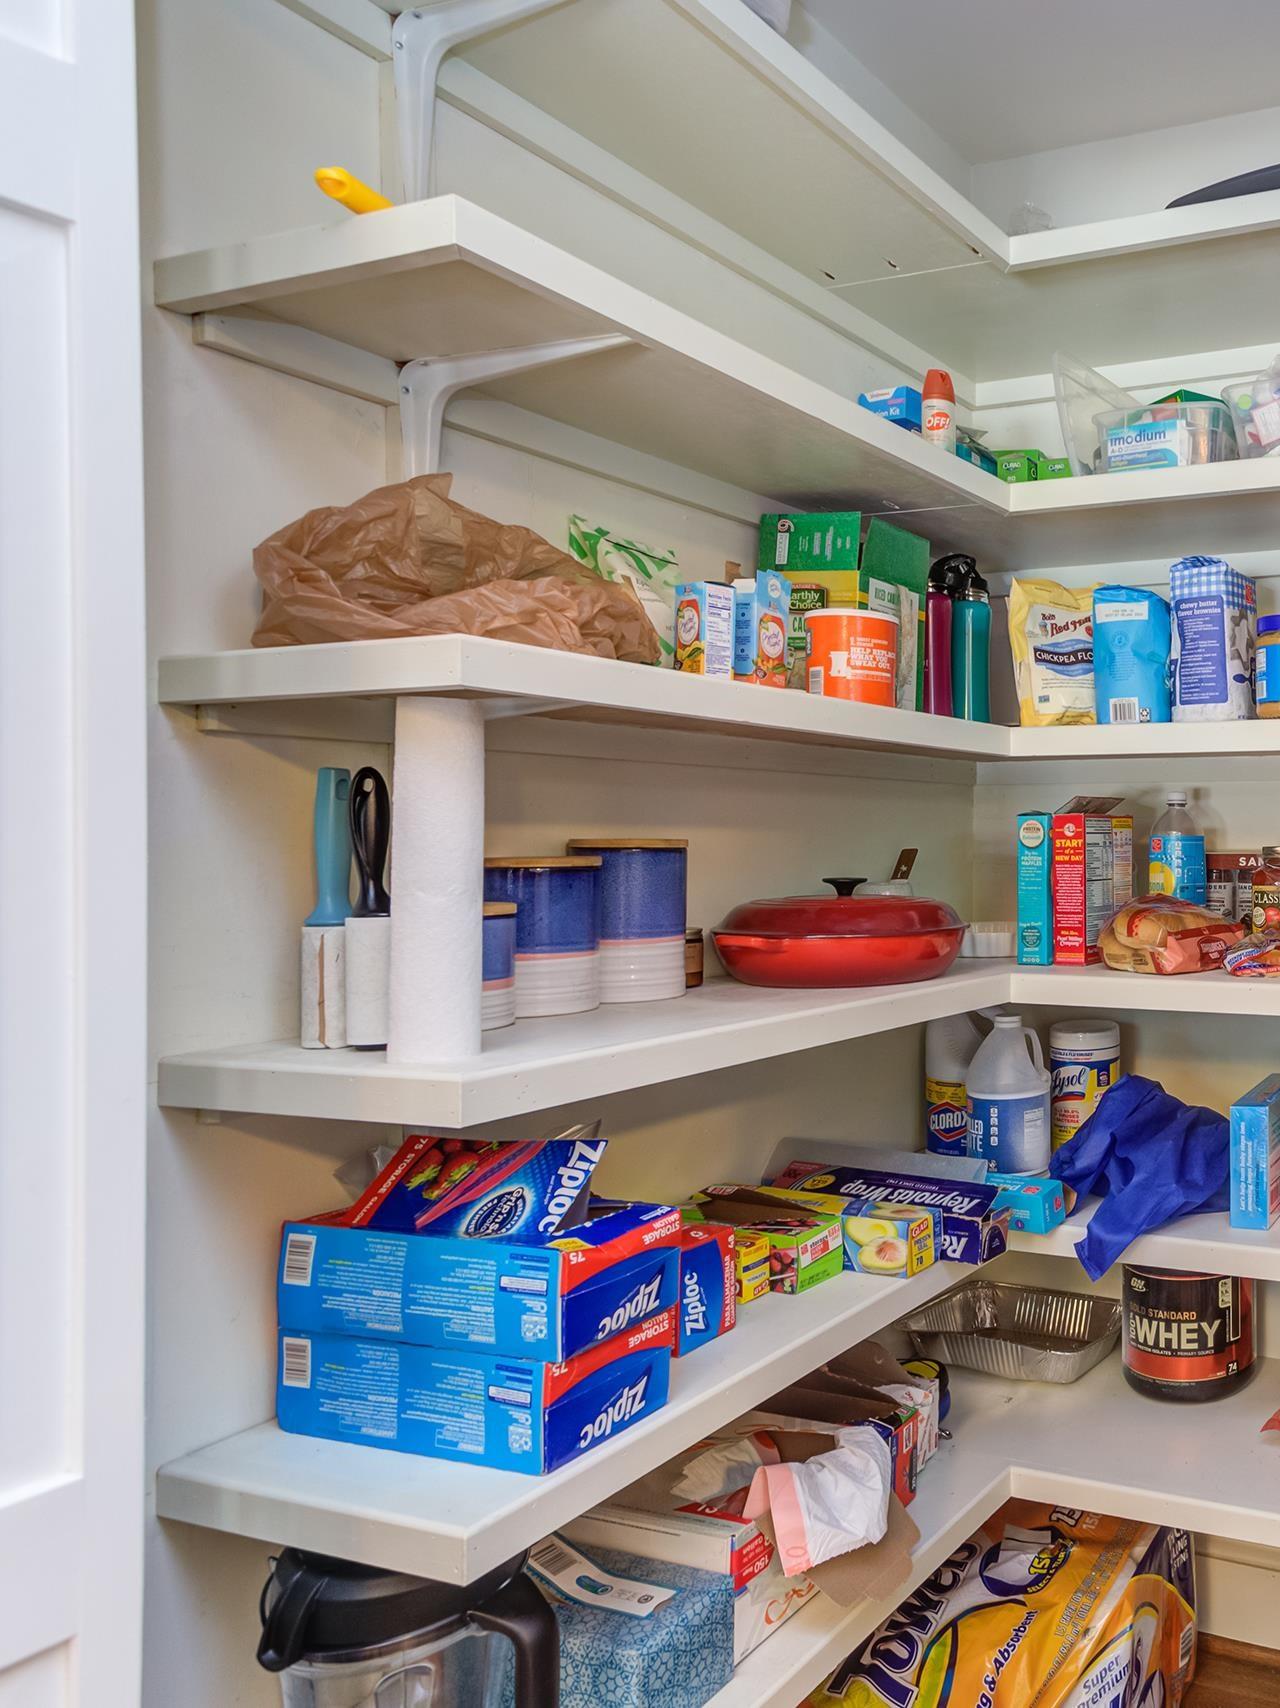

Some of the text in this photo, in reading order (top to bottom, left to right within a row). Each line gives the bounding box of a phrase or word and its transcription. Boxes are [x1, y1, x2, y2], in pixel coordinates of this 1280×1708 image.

[925, 415, 950, 429] OFF!
[789, 590, 820, 601] arthly
[789, 600, 822, 609] Choice
[1180, 602, 1198, 610] chewy
[1194, 607, 1221, 615] brownies
[1050, 622, 1069, 637] Red
[1036, 651, 1093, 663] CHICKPEA FLO
[1055, 839, 1083, 847] START
[351, 1138, 428, 1225] 75 STORAGE GALLON
[538, 1141, 606, 1236] Ziploc
[840, 1179, 981, 1214] Reynolds Wrap
[652, 1213, 680, 1230] GALLON
[910, 1218, 929, 1237] GLAD
[642, 1221, 680, 1245] STORAGE
[917, 1242, 929, 1252] SEAL
[569, 1252, 586, 1264] 75
[916, 1255, 924, 1267] 70
[598, 1275, 661, 1340] Ziploc
[684, 1272, 707, 1336] Ziploc
[642, 1312, 669, 1330] GALLON
[1147, 1308, 1197, 1321] STANDARD
[628, 1320, 669, 1348] STORAGE
[1135, 1315, 1222, 1350] WHEY
[1152, 1348, 1172, 1356] ISOLATES
[552, 1362, 568, 1377] 75
[1228, 1362, 1238, 1372] 74
[580, 1376, 648, 1449] Ziploc
[753, 1555, 769, 1573] 150
[983, 1608, 1039, 1694] & Absorbent
[1082, 1653, 1121, 1696] Super
